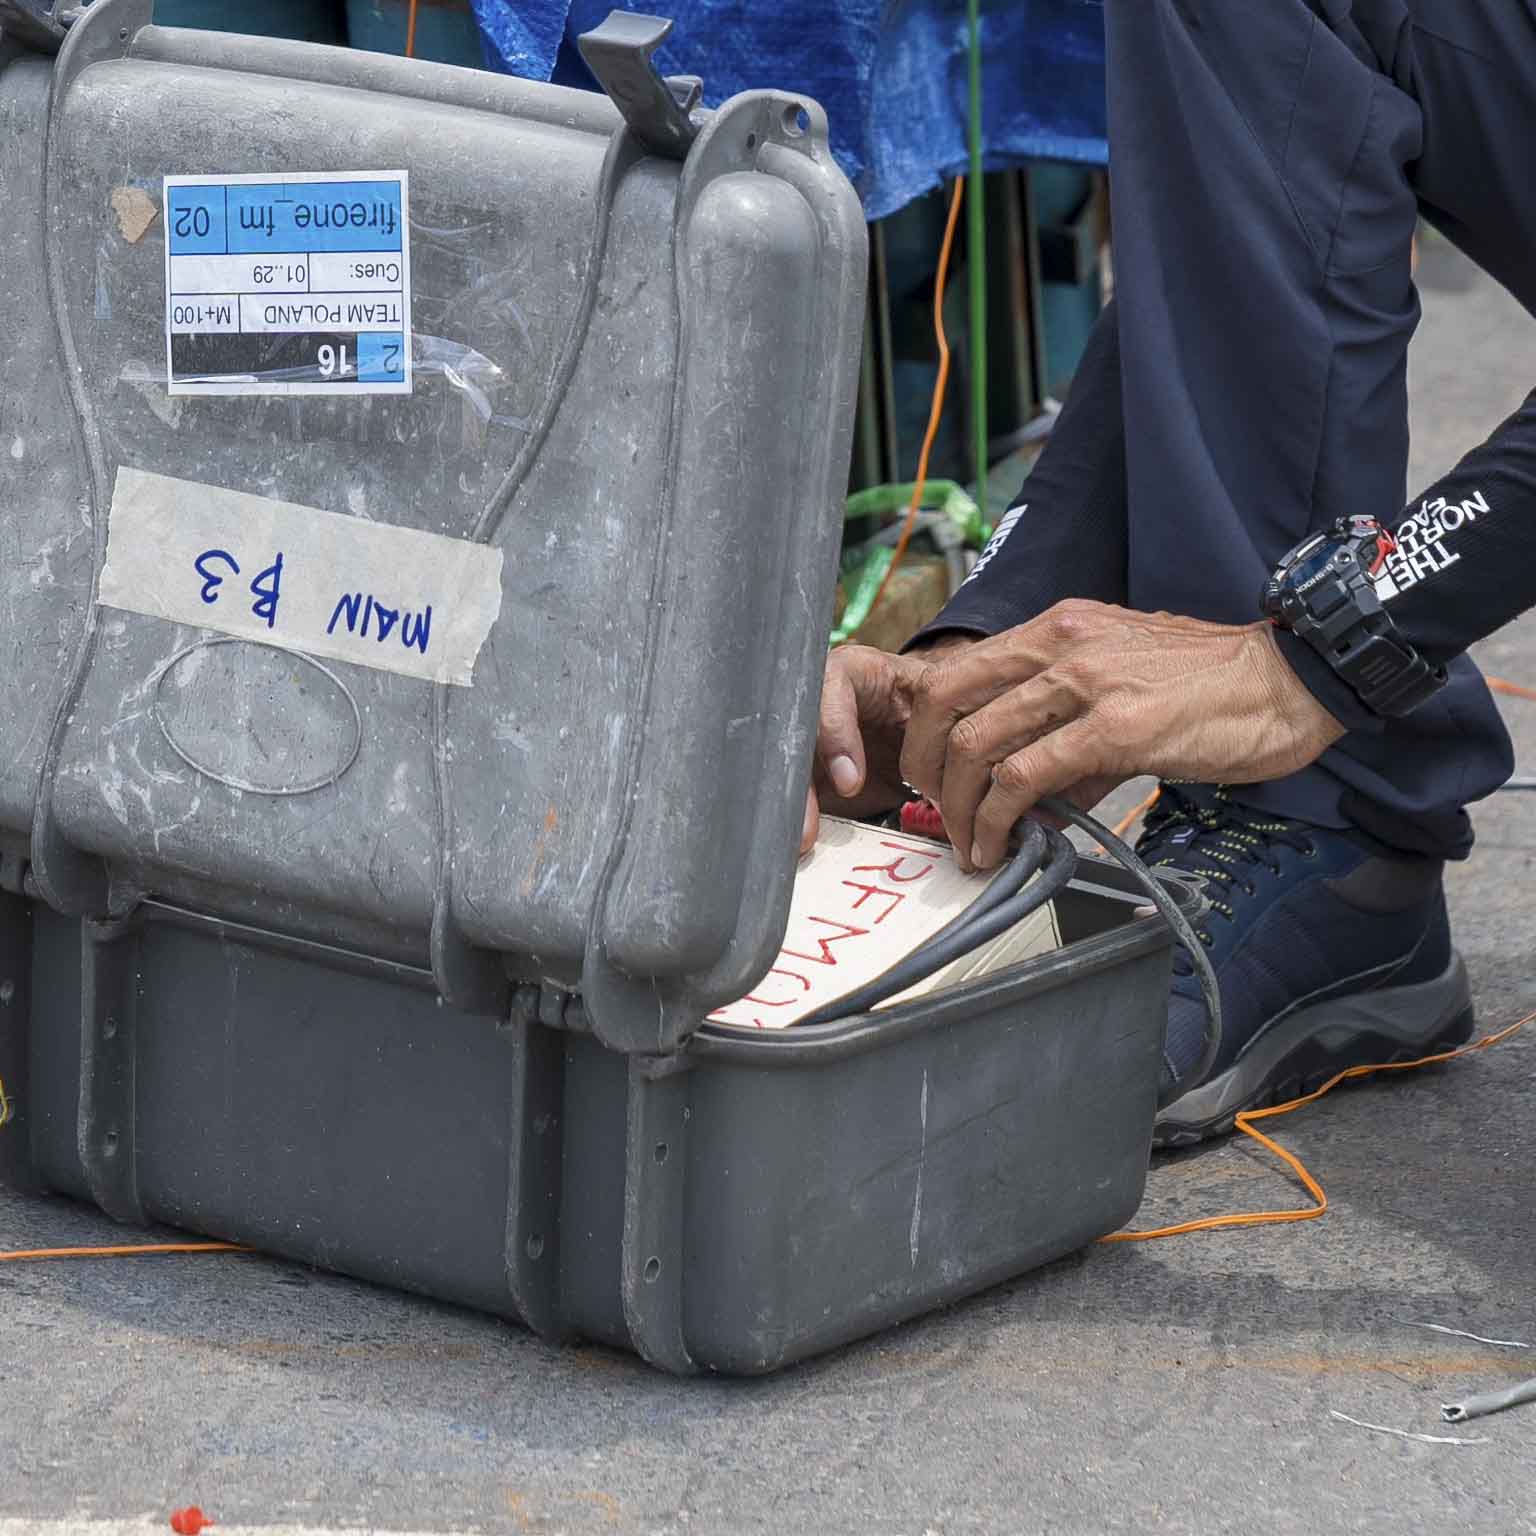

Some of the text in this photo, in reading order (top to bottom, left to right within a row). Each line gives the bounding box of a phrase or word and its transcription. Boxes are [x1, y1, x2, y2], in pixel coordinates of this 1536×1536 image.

[174, 205, 211, 238] 02
[238, 198, 398, 237] fireone_fm
[252, 264, 307, 284] 01..29
[348, 262, 401, 283] Cues:
[173, 305, 231, 325] M+100
[263, 302, 401, 325] TEAM POLAND
[316, 342, 401, 377] 2 16
[1384, 489, 1491, 570] NORTH
[1393, 496, 1447, 543] FAC
[1390, 540, 1461, 592] THE
[325, 591, 434, 655] MAIN
